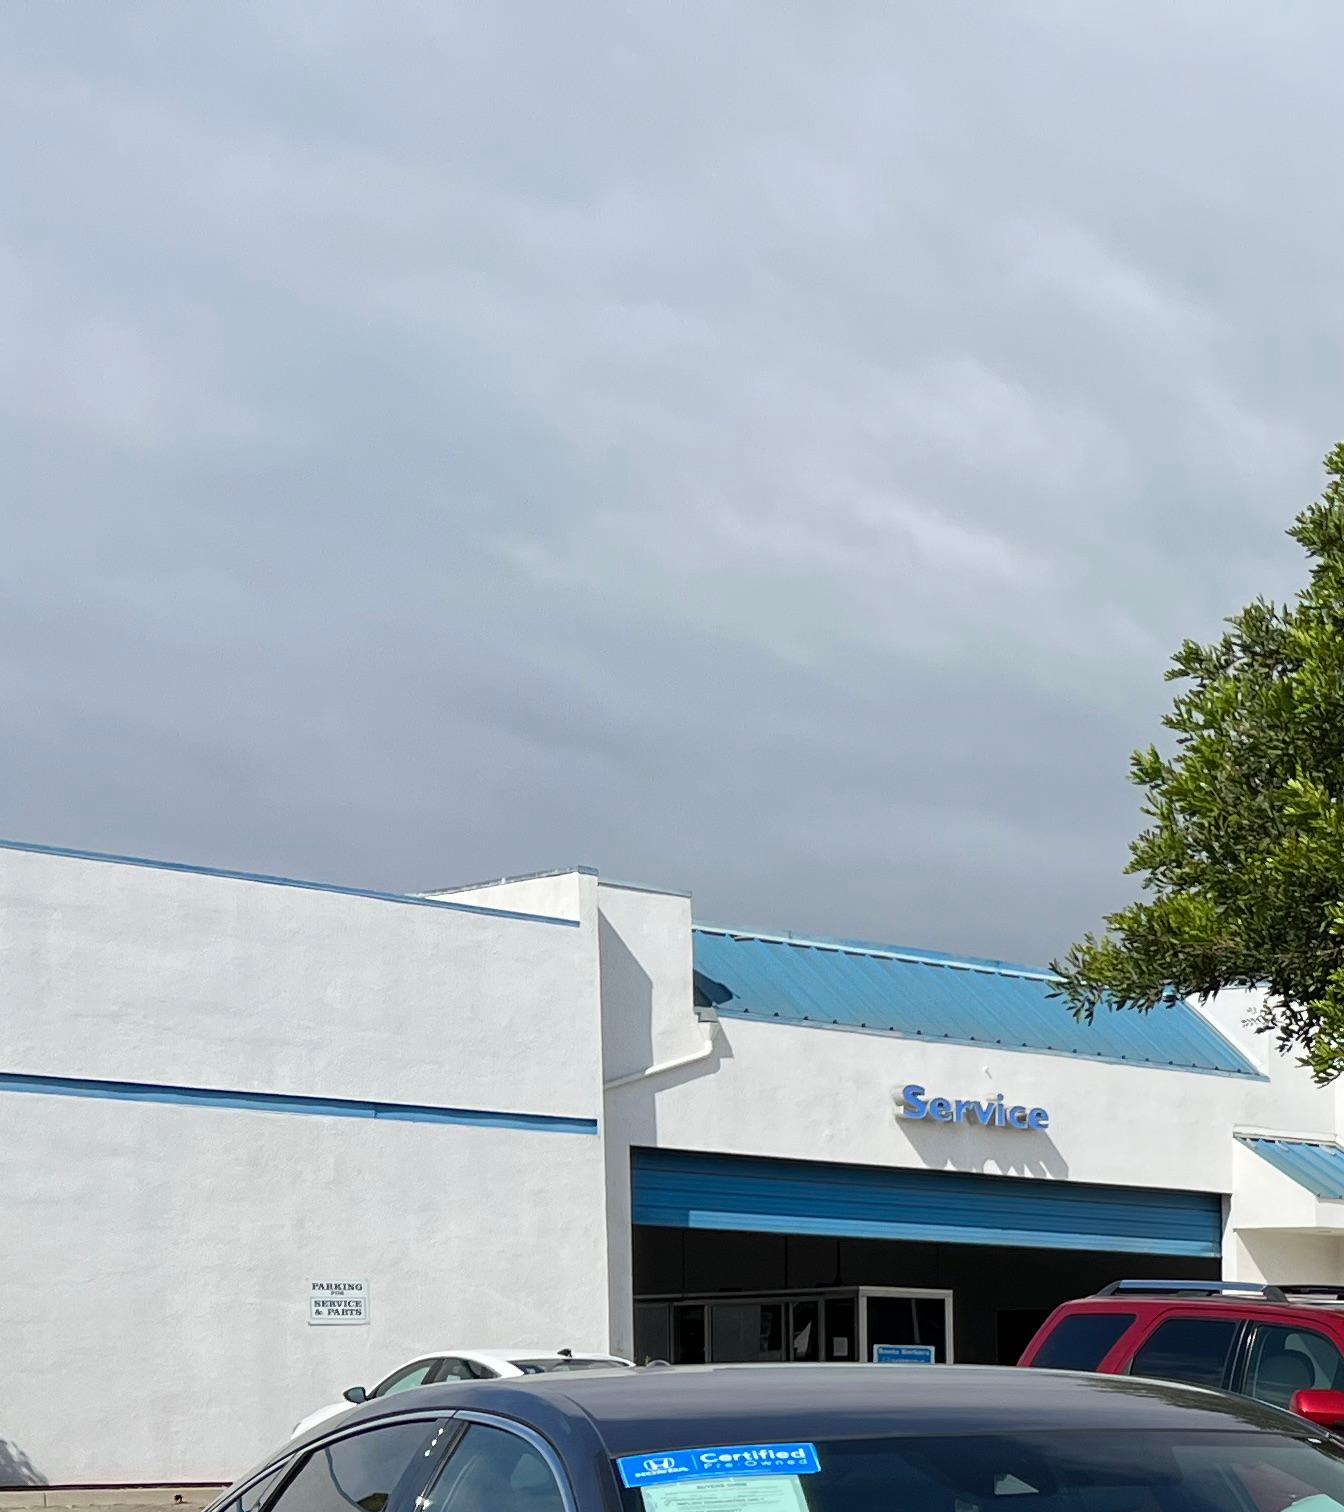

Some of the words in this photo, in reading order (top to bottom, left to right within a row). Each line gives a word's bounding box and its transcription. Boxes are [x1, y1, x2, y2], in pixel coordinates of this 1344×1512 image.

[902, 1084, 1050, 1131] Service
[311, 1282, 363, 1291] PARKING
[314, 1300, 362, 1308] SERVICE
[327, 1308, 362, 1316] PARTS
[699, 1448, 806, 1463] Certified
